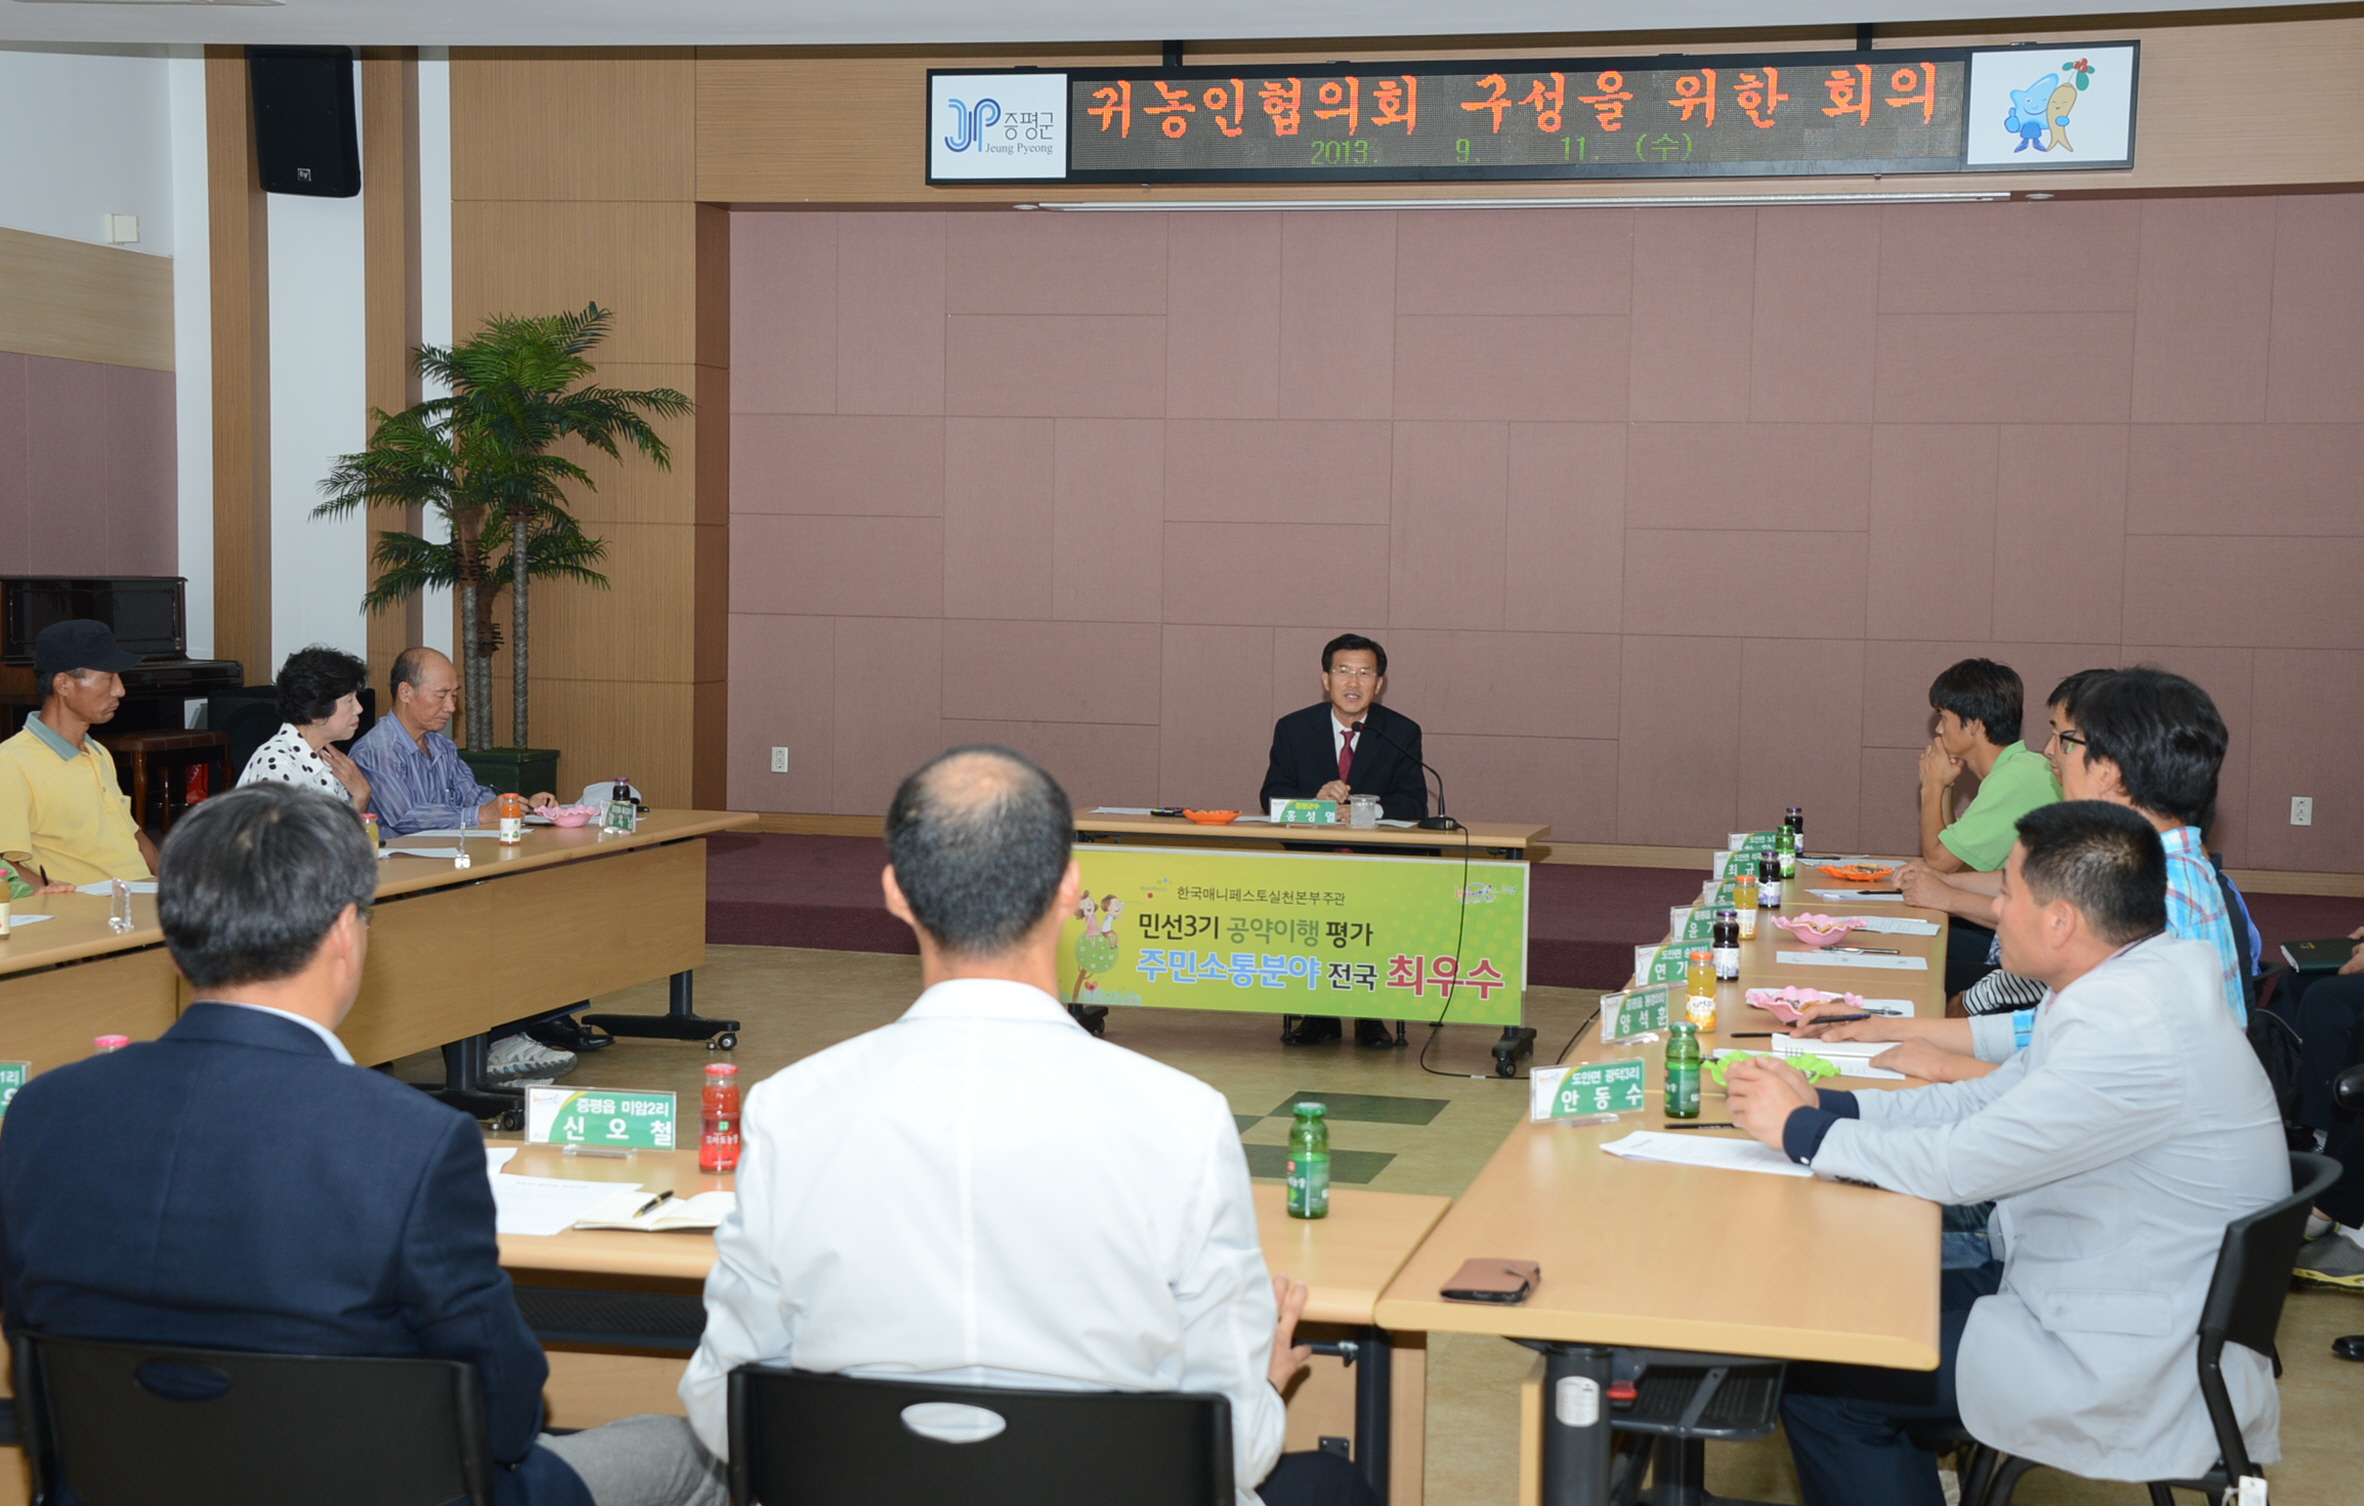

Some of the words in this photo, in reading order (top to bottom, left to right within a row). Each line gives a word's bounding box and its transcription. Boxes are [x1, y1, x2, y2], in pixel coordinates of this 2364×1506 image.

[1087, 75, 1417, 139] 귀농인협의회
[1460, 69, 1634, 133] 구성을
[1667, 67, 1790, 129] 위한
[1821, 61, 1938, 126] 회의
[1004, 111, 1054, 141] 증평군
[985, 143, 1014, 155] Jeung
[1017, 142, 1054, 155] Pyeong
[1310, 140, 1379, 166] 2013.
[1455, 138, 1481, 164] 9.
[1562, 136, 1600, 162] 11.
[1635, 133, 1693, 161] (수)
[1177, 886, 1321, 905] 한국매니페스토실천본부
[1139, 913, 1219, 940] 민선3기
[1226, 916, 1320, 948] 공약이행
[1325, 921, 1374, 949] 평가
[1136, 948, 1322, 991] 주민소통분야
[1327, 962, 1378, 992] 전국
[1386, 953, 1505, 1000] 최우수
[1571, 1069, 1602, 1086] 도안면
[1604, 1066, 1640, 1083] 광덕3리
[576, 1098, 616, 1115] 증평읍
[621, 1100, 669, 1118] 미암2리
